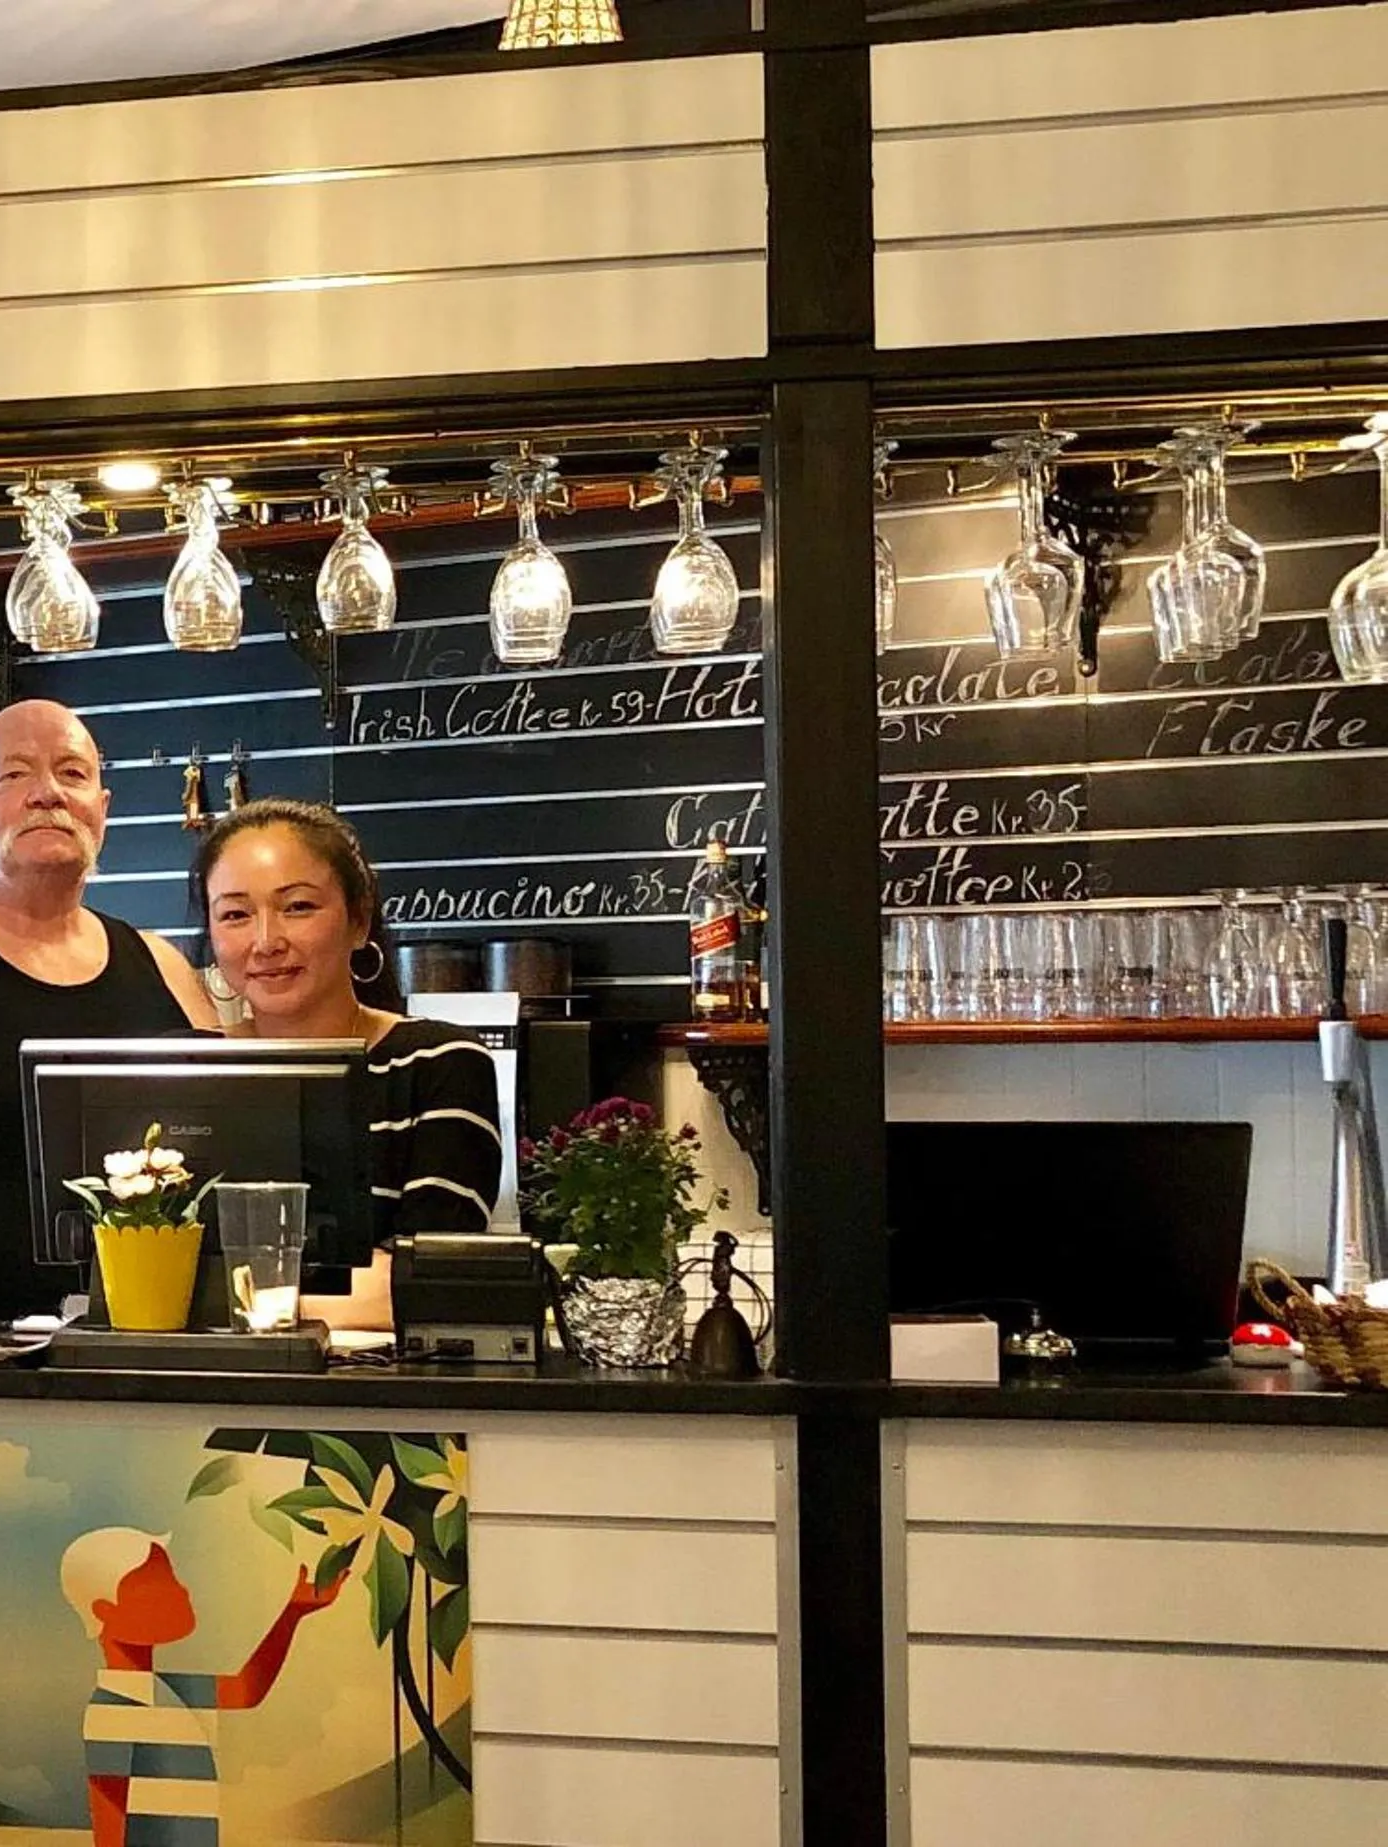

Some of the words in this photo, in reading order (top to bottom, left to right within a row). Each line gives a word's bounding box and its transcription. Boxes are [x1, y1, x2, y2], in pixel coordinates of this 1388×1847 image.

[348, 687, 436, 745] Irish
[654, 660, 762, 720] Hot
[381, 876, 596, 922] appucino
